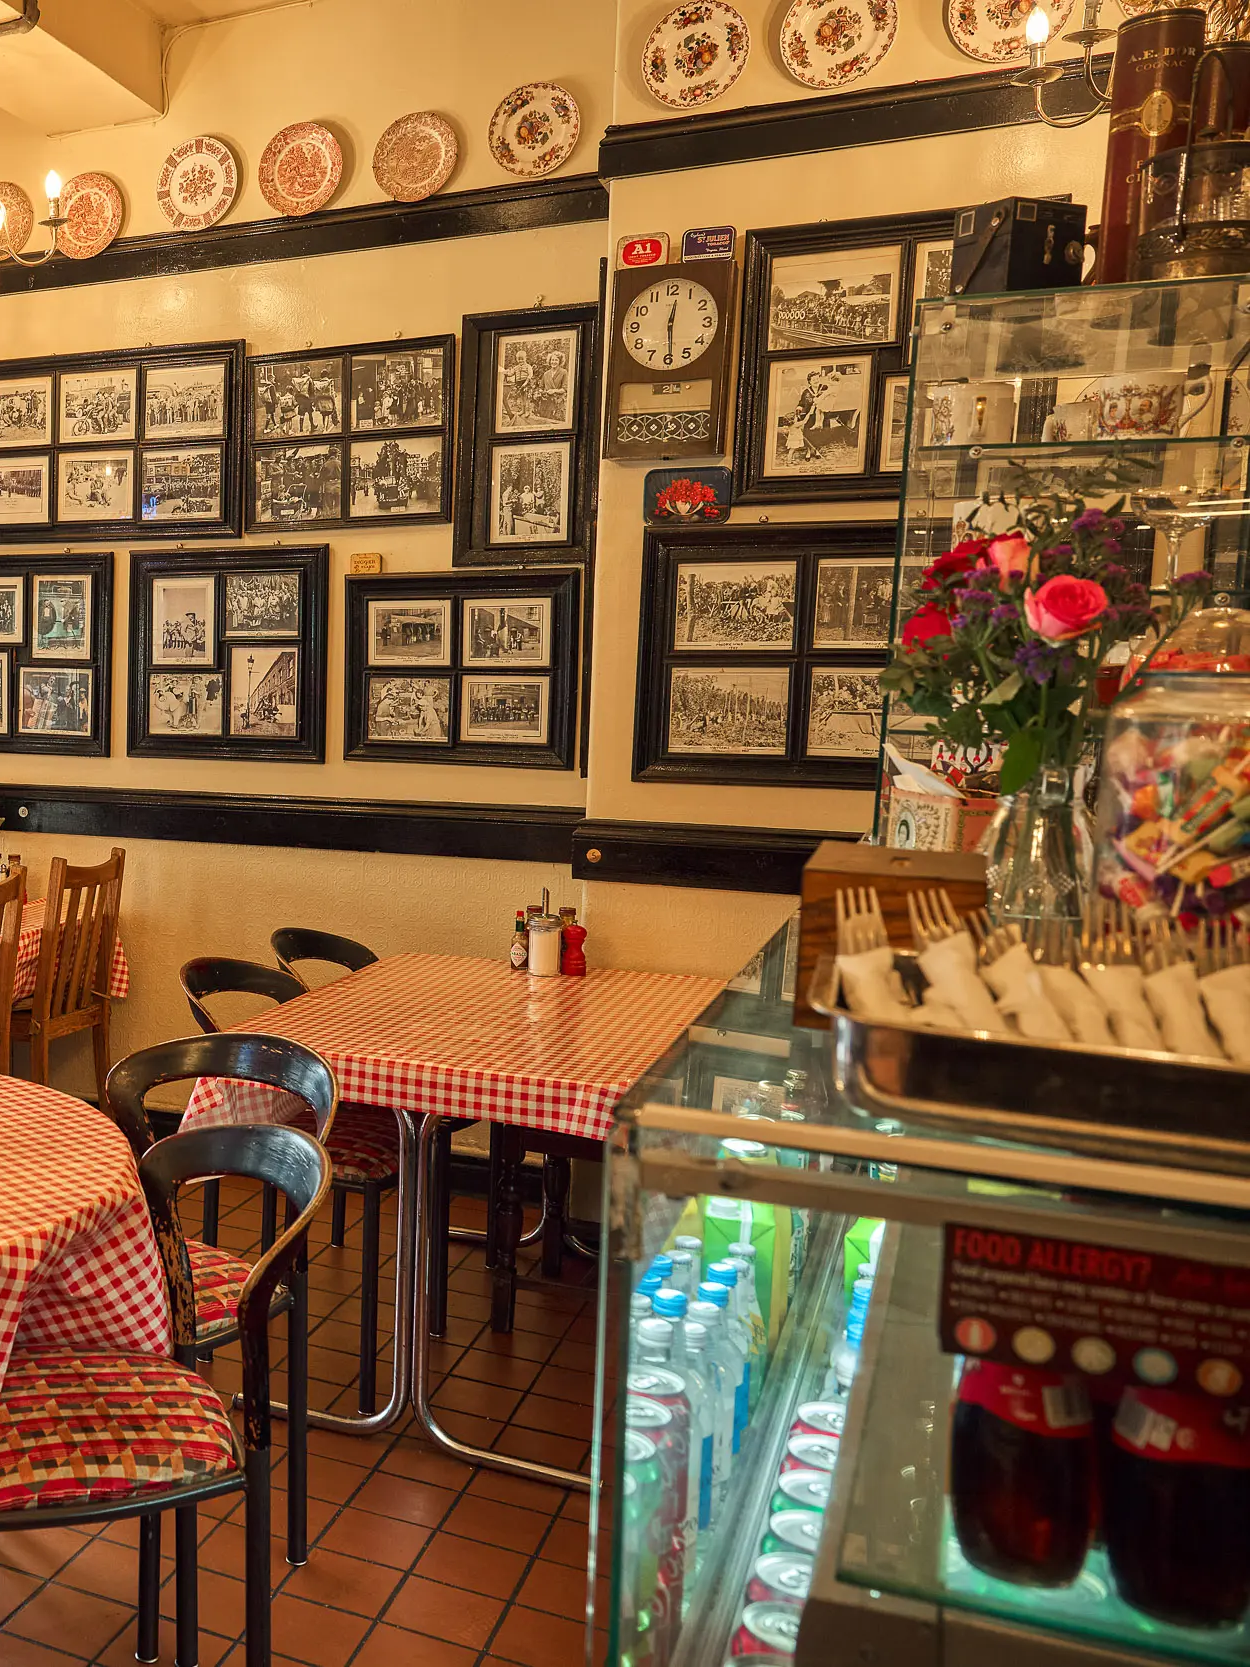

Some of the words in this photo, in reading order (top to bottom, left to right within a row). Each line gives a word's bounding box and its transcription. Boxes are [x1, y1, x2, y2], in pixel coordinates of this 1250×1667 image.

[631, 242, 652, 255] A1
[666, 284, 680, 297] 12
[688, 288, 693, 300] 1
[650, 291, 659, 303] 11
[635, 305, 649, 317] 10
[697, 299, 708, 311] 2
[630, 321, 640, 333] 9
[702, 316, 712, 328] 3
[634, 338, 644, 350] 8
[694, 334, 705, 345] 4
[646, 349, 656, 361] 7
[662, 353, 673, 365] 6
[681, 347, 692, 359] 5
[953, 1228, 1021, 1266] FOOD
[1026, 1239, 1150, 1288] ALLERGY?
